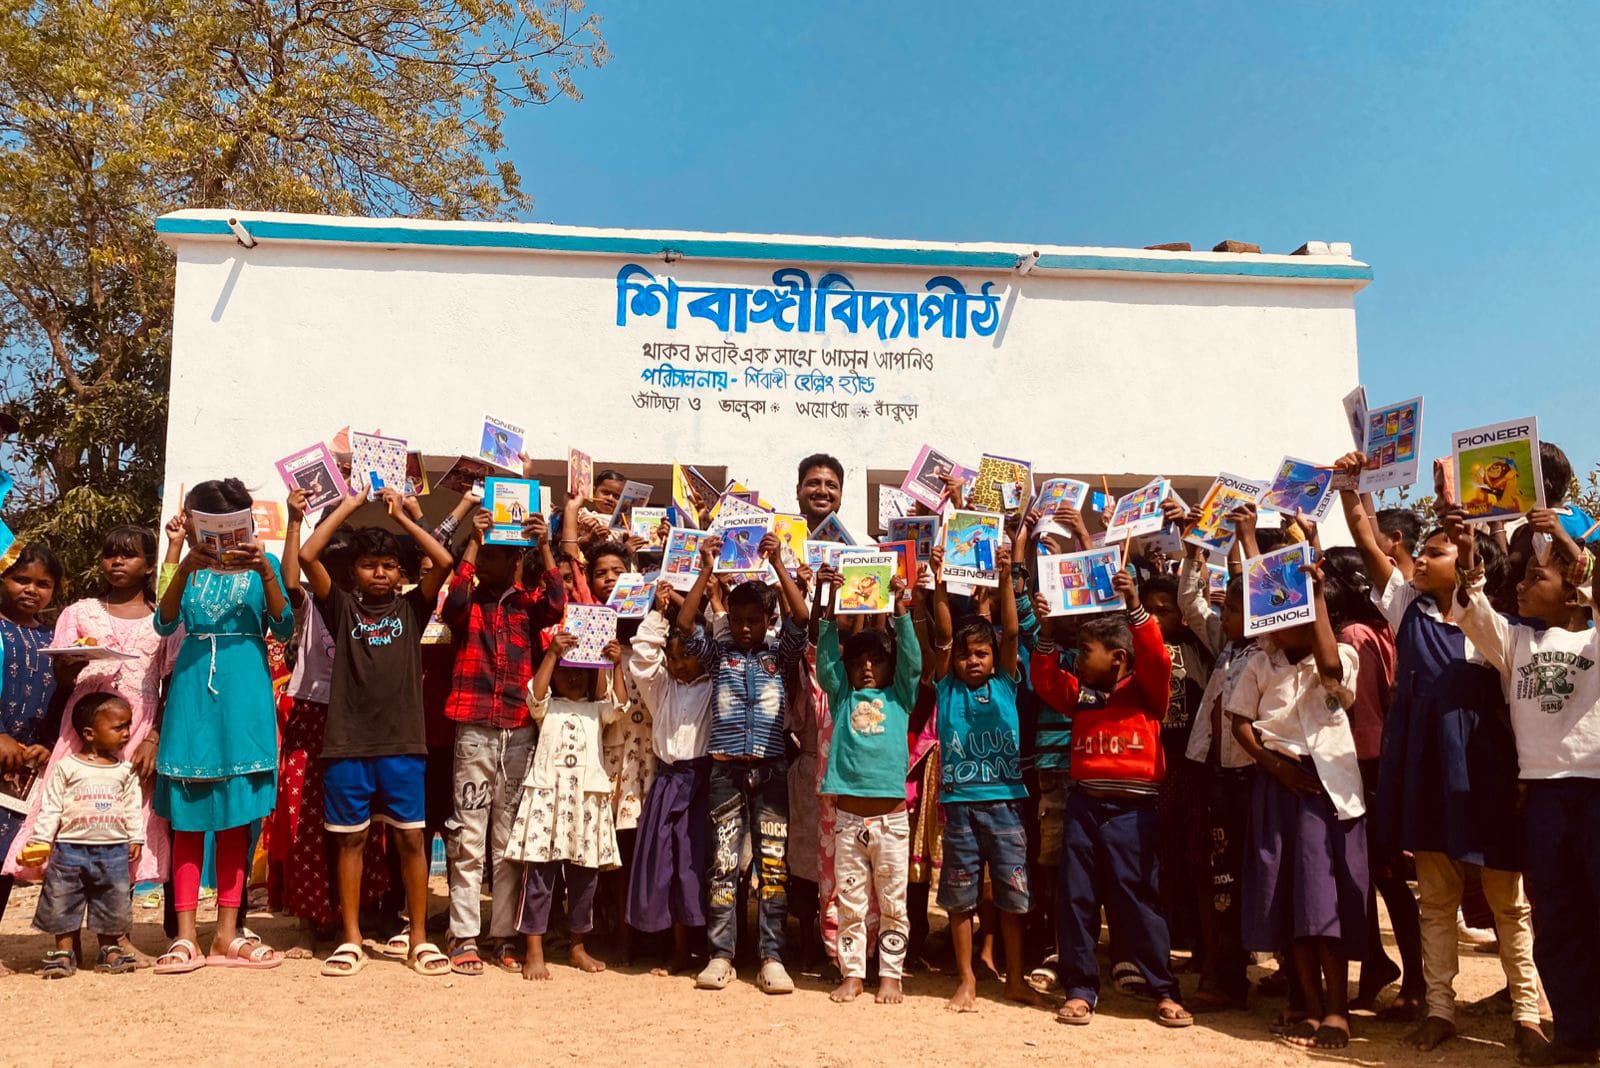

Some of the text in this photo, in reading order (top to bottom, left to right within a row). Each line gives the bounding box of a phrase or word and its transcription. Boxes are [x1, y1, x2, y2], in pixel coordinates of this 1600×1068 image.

[642, 343, 690, 361] থাকব
[775, 349, 818, 367] সাথে
[874, 347, 933, 370] আপনিও
[688, 398, 701, 411] ও
[718, 399, 766, 422] ভালুকা
[1457, 425, 1529, 448] PIONEER
[1216, 476, 1260, 496] PIONEER
[1316, 489, 1334, 518] NEER
[723, 517, 769, 526] PIONEER
[843, 556, 892, 564] PIONEER
[943, 567, 995, 580] PIONEER
[1250, 608, 1310, 630] PIONEER
[760, 821, 788, 838] ROCK
